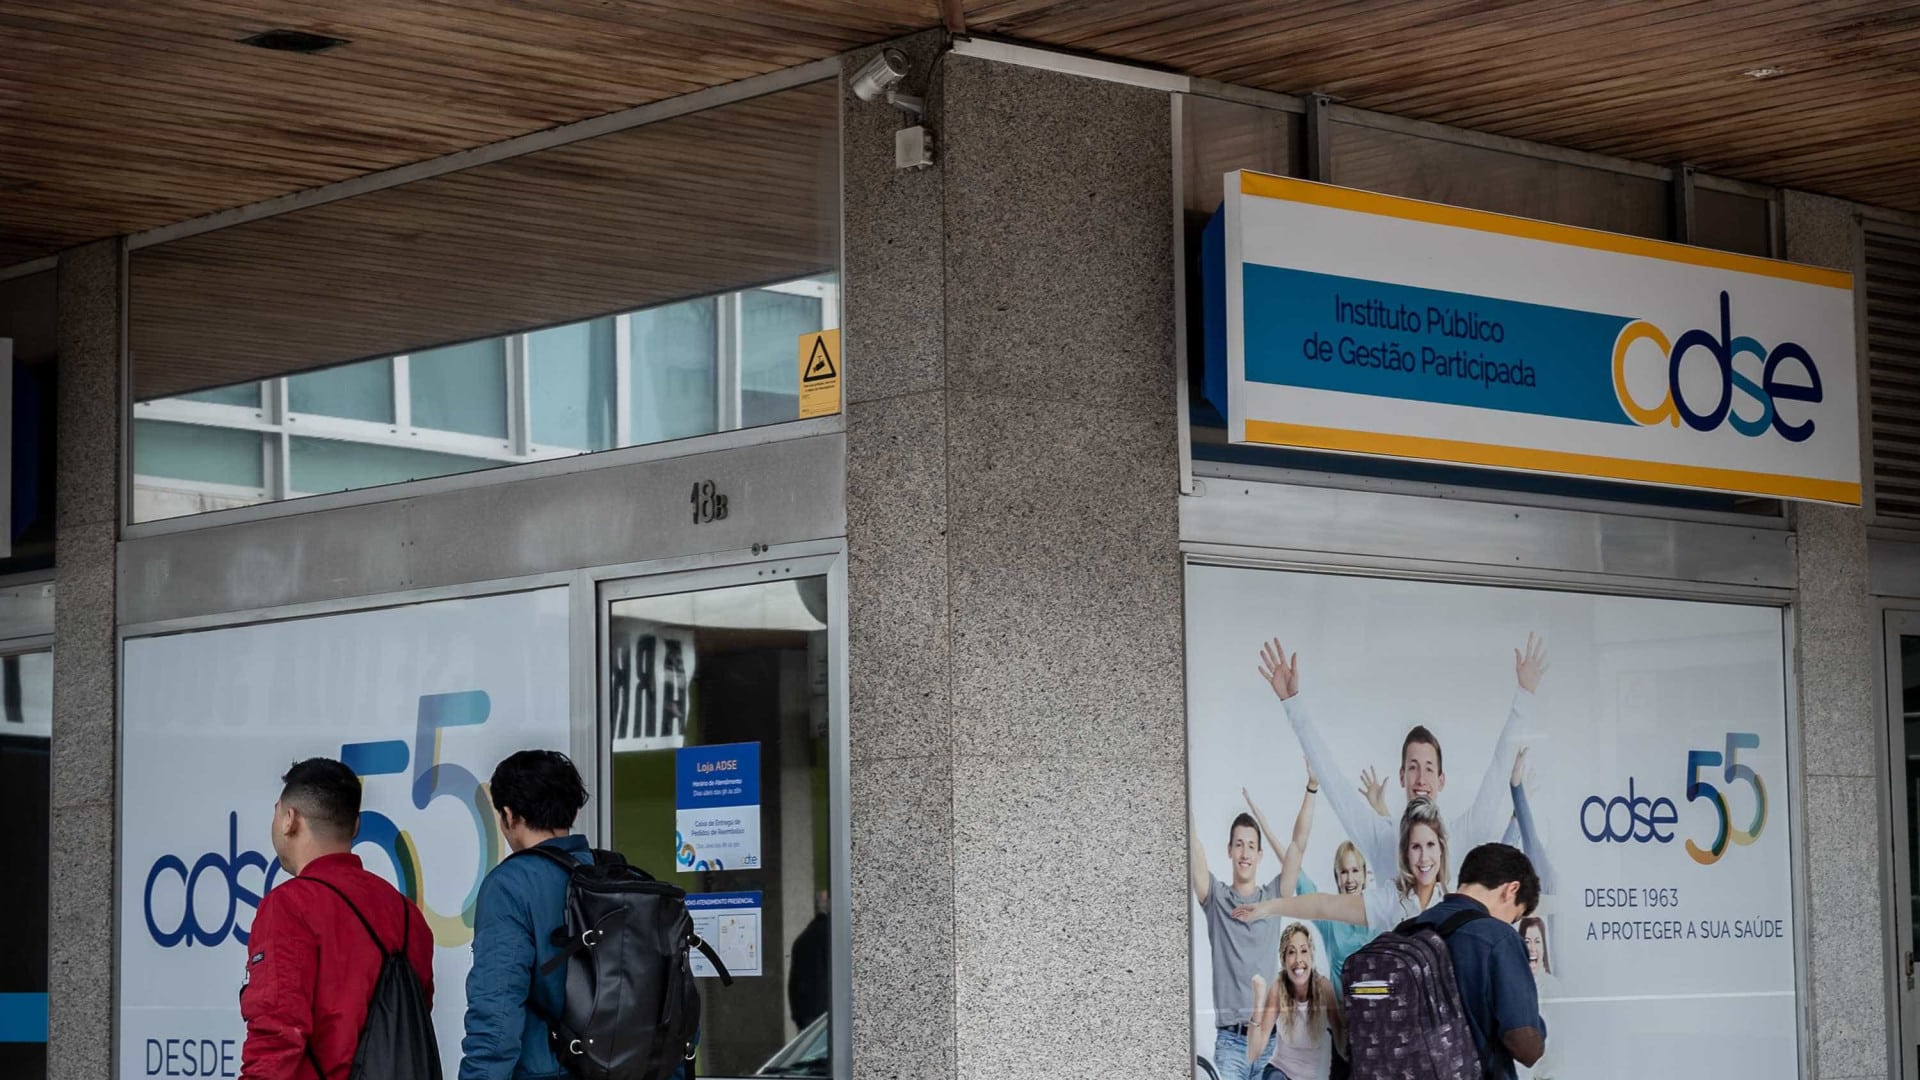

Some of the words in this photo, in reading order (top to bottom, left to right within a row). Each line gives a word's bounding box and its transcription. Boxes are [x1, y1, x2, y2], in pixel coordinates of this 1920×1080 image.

[1334, 293, 1421, 333] Instituto
[1427, 306, 1504, 344] Público
[1303, 332, 1334, 362] de
[1338, 336, 1416, 373] Gestão
[1421, 346, 1537, 389] Participada
[1613, 290, 1823, 442] adse
[696, 762, 714, 774] Loja
[715, 760, 737, 771] ADSE
[1580, 776, 1679, 844] adse
[1685, 732, 1769, 865] 55
[144, 810, 288, 948] ads
[1584, 888, 1638, 908] DESDE
[1642, 888, 1679, 908] 1963
[1586, 921, 1598, 941] A
[1602, 921, 1682, 941] PROTEGER
[1686, 920, 1697, 939] A
[1700, 920, 1731, 939] SUA
[1734, 915, 1784, 939] SAÚDE
[146, 1038, 236, 1077] DESDE
